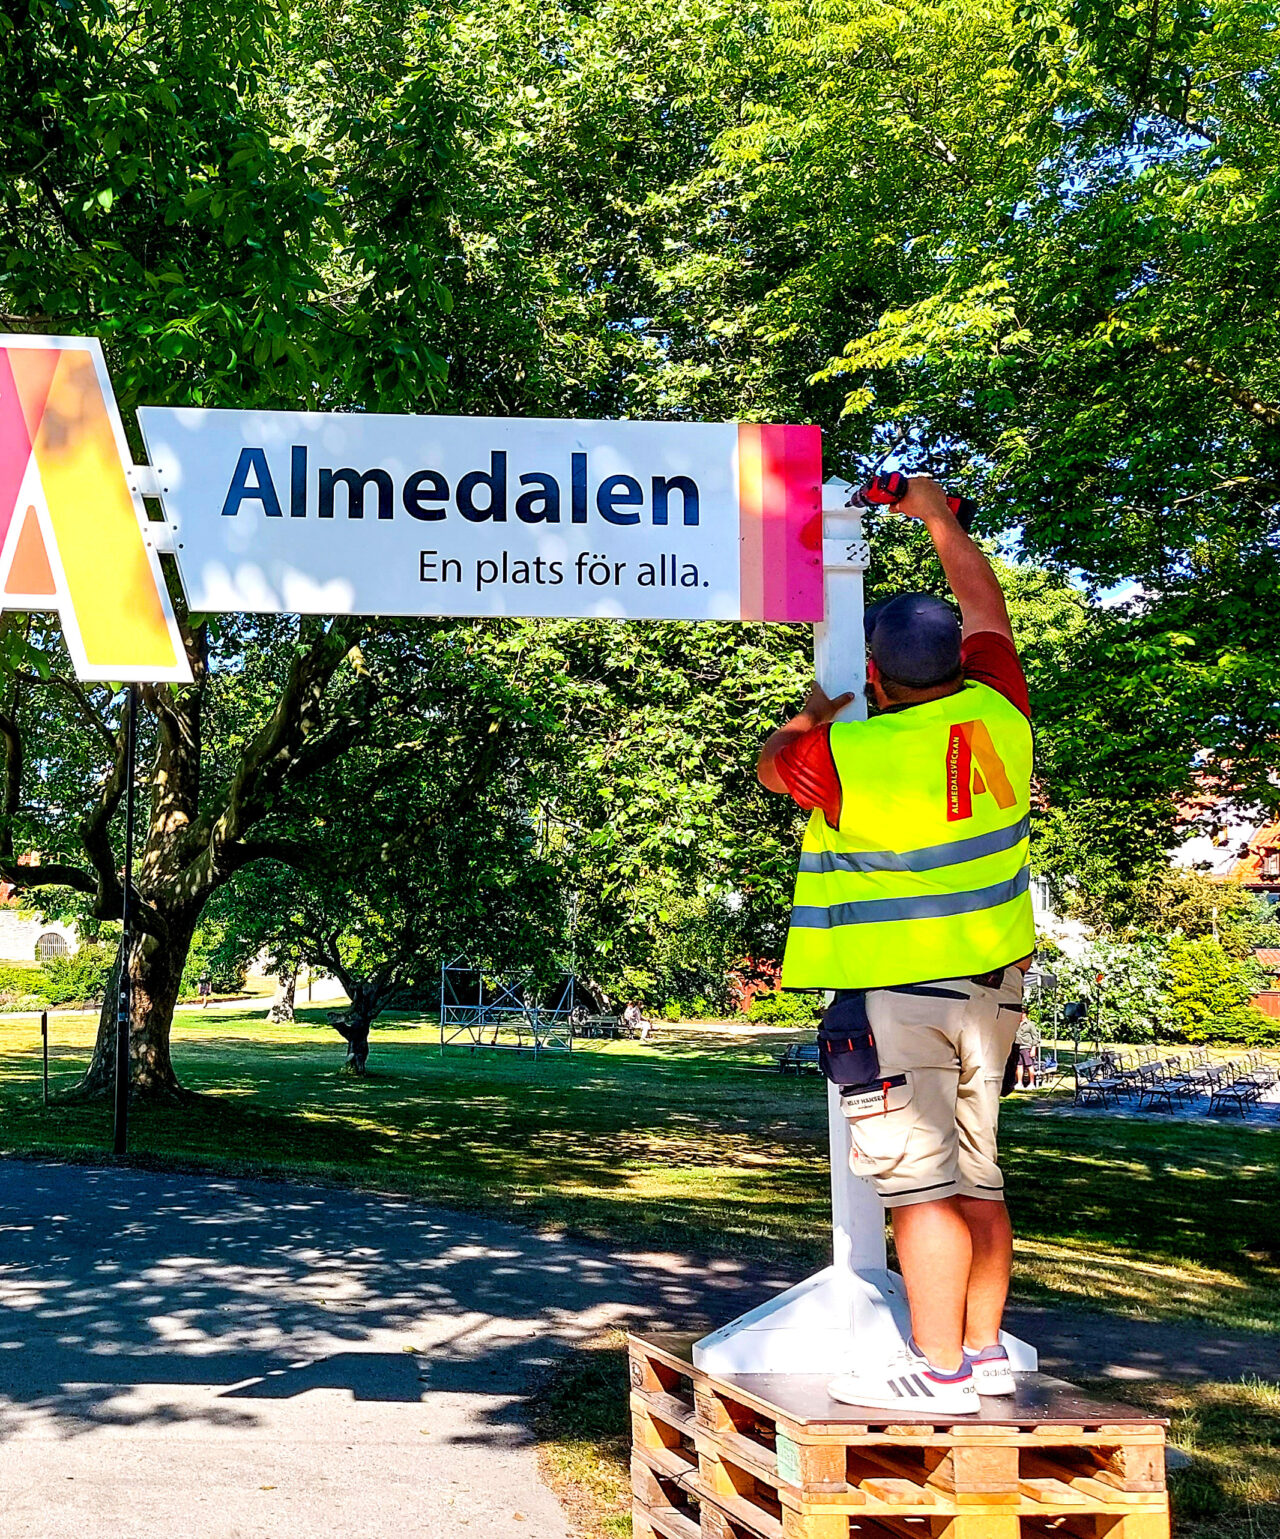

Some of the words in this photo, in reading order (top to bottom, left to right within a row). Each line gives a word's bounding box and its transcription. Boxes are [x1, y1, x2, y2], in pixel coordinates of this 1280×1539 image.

[220, 445, 701, 528] Almedalen
[418, 549, 463, 584] En
[476, 550, 565, 592] plats
[574, 550, 628, 587] för
[637, 553, 710, 590] alla.
[950, 736, 960, 814] ALMEDALSVECKAN
